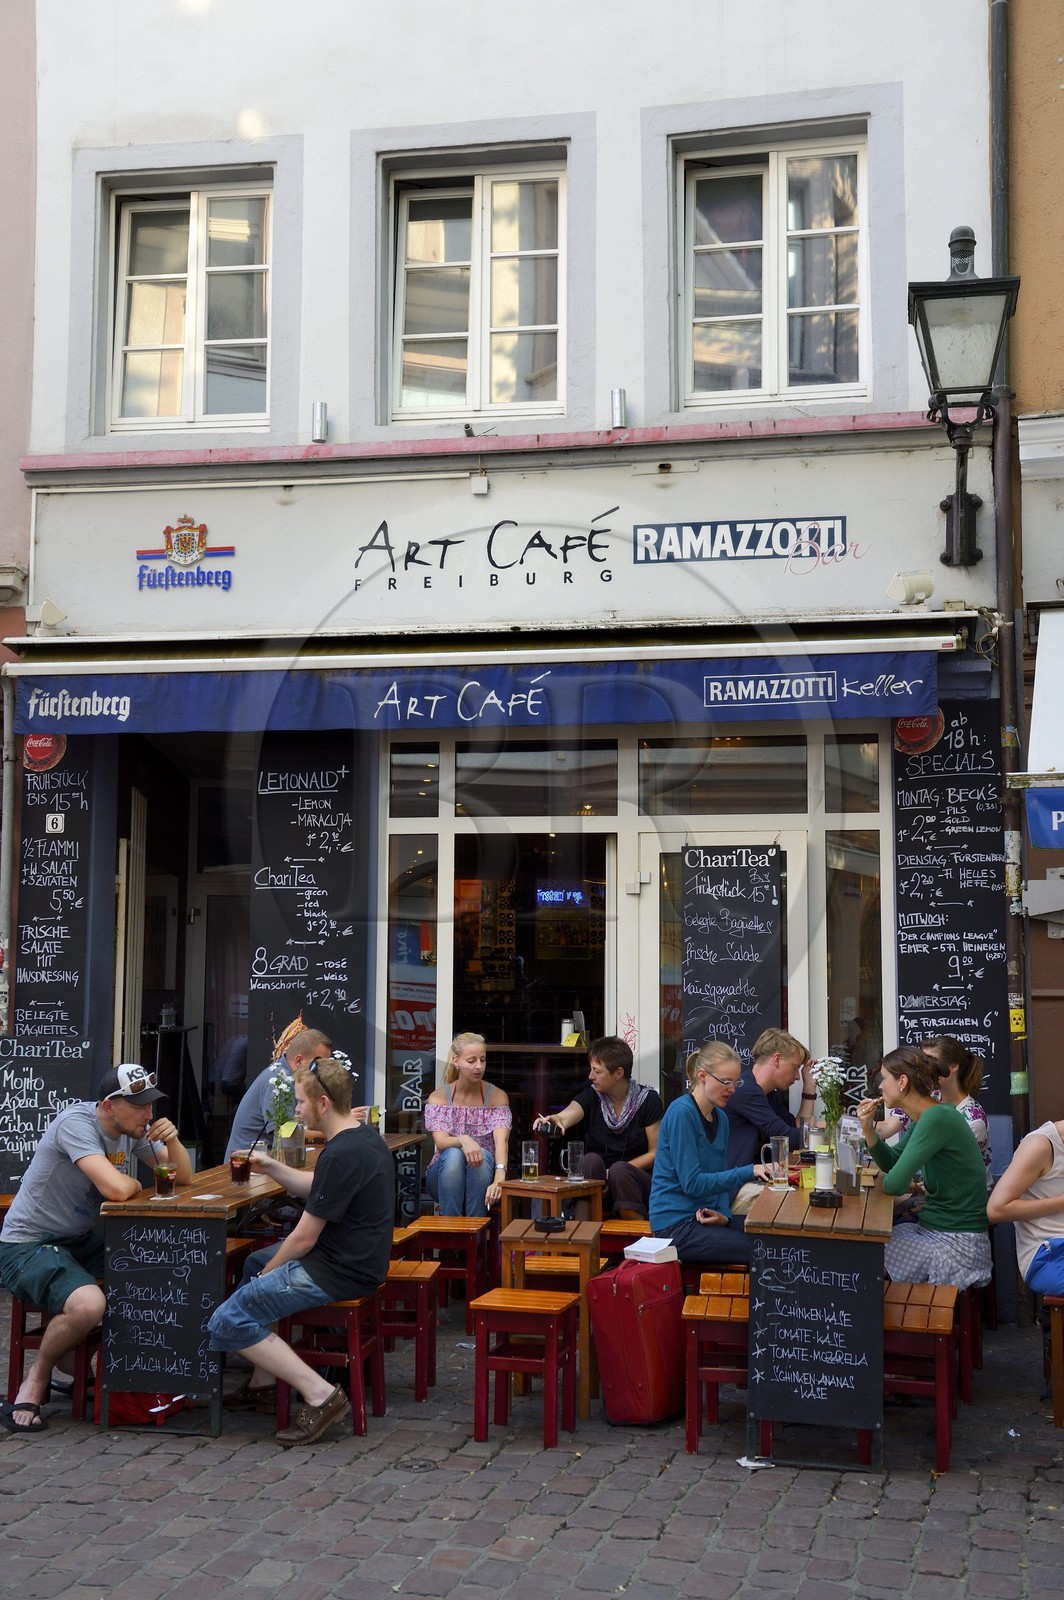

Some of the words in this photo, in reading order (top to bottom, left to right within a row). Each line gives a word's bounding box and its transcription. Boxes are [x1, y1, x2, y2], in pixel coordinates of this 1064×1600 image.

[636, 519, 847, 561] RAMAZZOTTI
[784, 521, 871, 575] Bar
[354, 569, 613, 593] FREIBURG
[709, 676, 834, 702] RAMAZZOTTI
[951, 711, 969, 728] ab
[943, 728, 965, 750] 18
[905, 749, 996, 776] SPECIALS
[26, 792, 48, 806] BIS
[51, 816, 59, 830] 6
[34, 838, 79, 859] FLAMMI
[685, 848, 770, 868] ChariTea
[41, 859, 78, 875] SALAT
[959, 867, 997, 880] HELLES
[35, 875, 78, 887] ZUTATEN
[253, 866, 317, 887] ChariTea
[959, 879, 991, 889] HEFE
[19, 925, 71, 940] FRISCHE
[919, 932, 961, 942] CHAMPIONS
[21, 941, 65, 955] SALATE
[898, 943, 930, 954] EIMER
[962, 941, 1006, 953] HEINEKEN
[37, 954, 56, 967] MIT
[252, 946, 268, 975] 8
[269, 954, 309, 974] GRAD
[16, 967, 79, 987] HAUSDRESSING
[249, 978, 307, 991] Weinschorle
[15, 1008, 70, 1022] BELEGTE
[15, 1023, 79, 1038] BAGUETTES
[0, 1039, 84, 1060] ChariTea
[401, 1057, 423, 1112] BAR
[752, 1239, 811, 1264] BELEGTE
